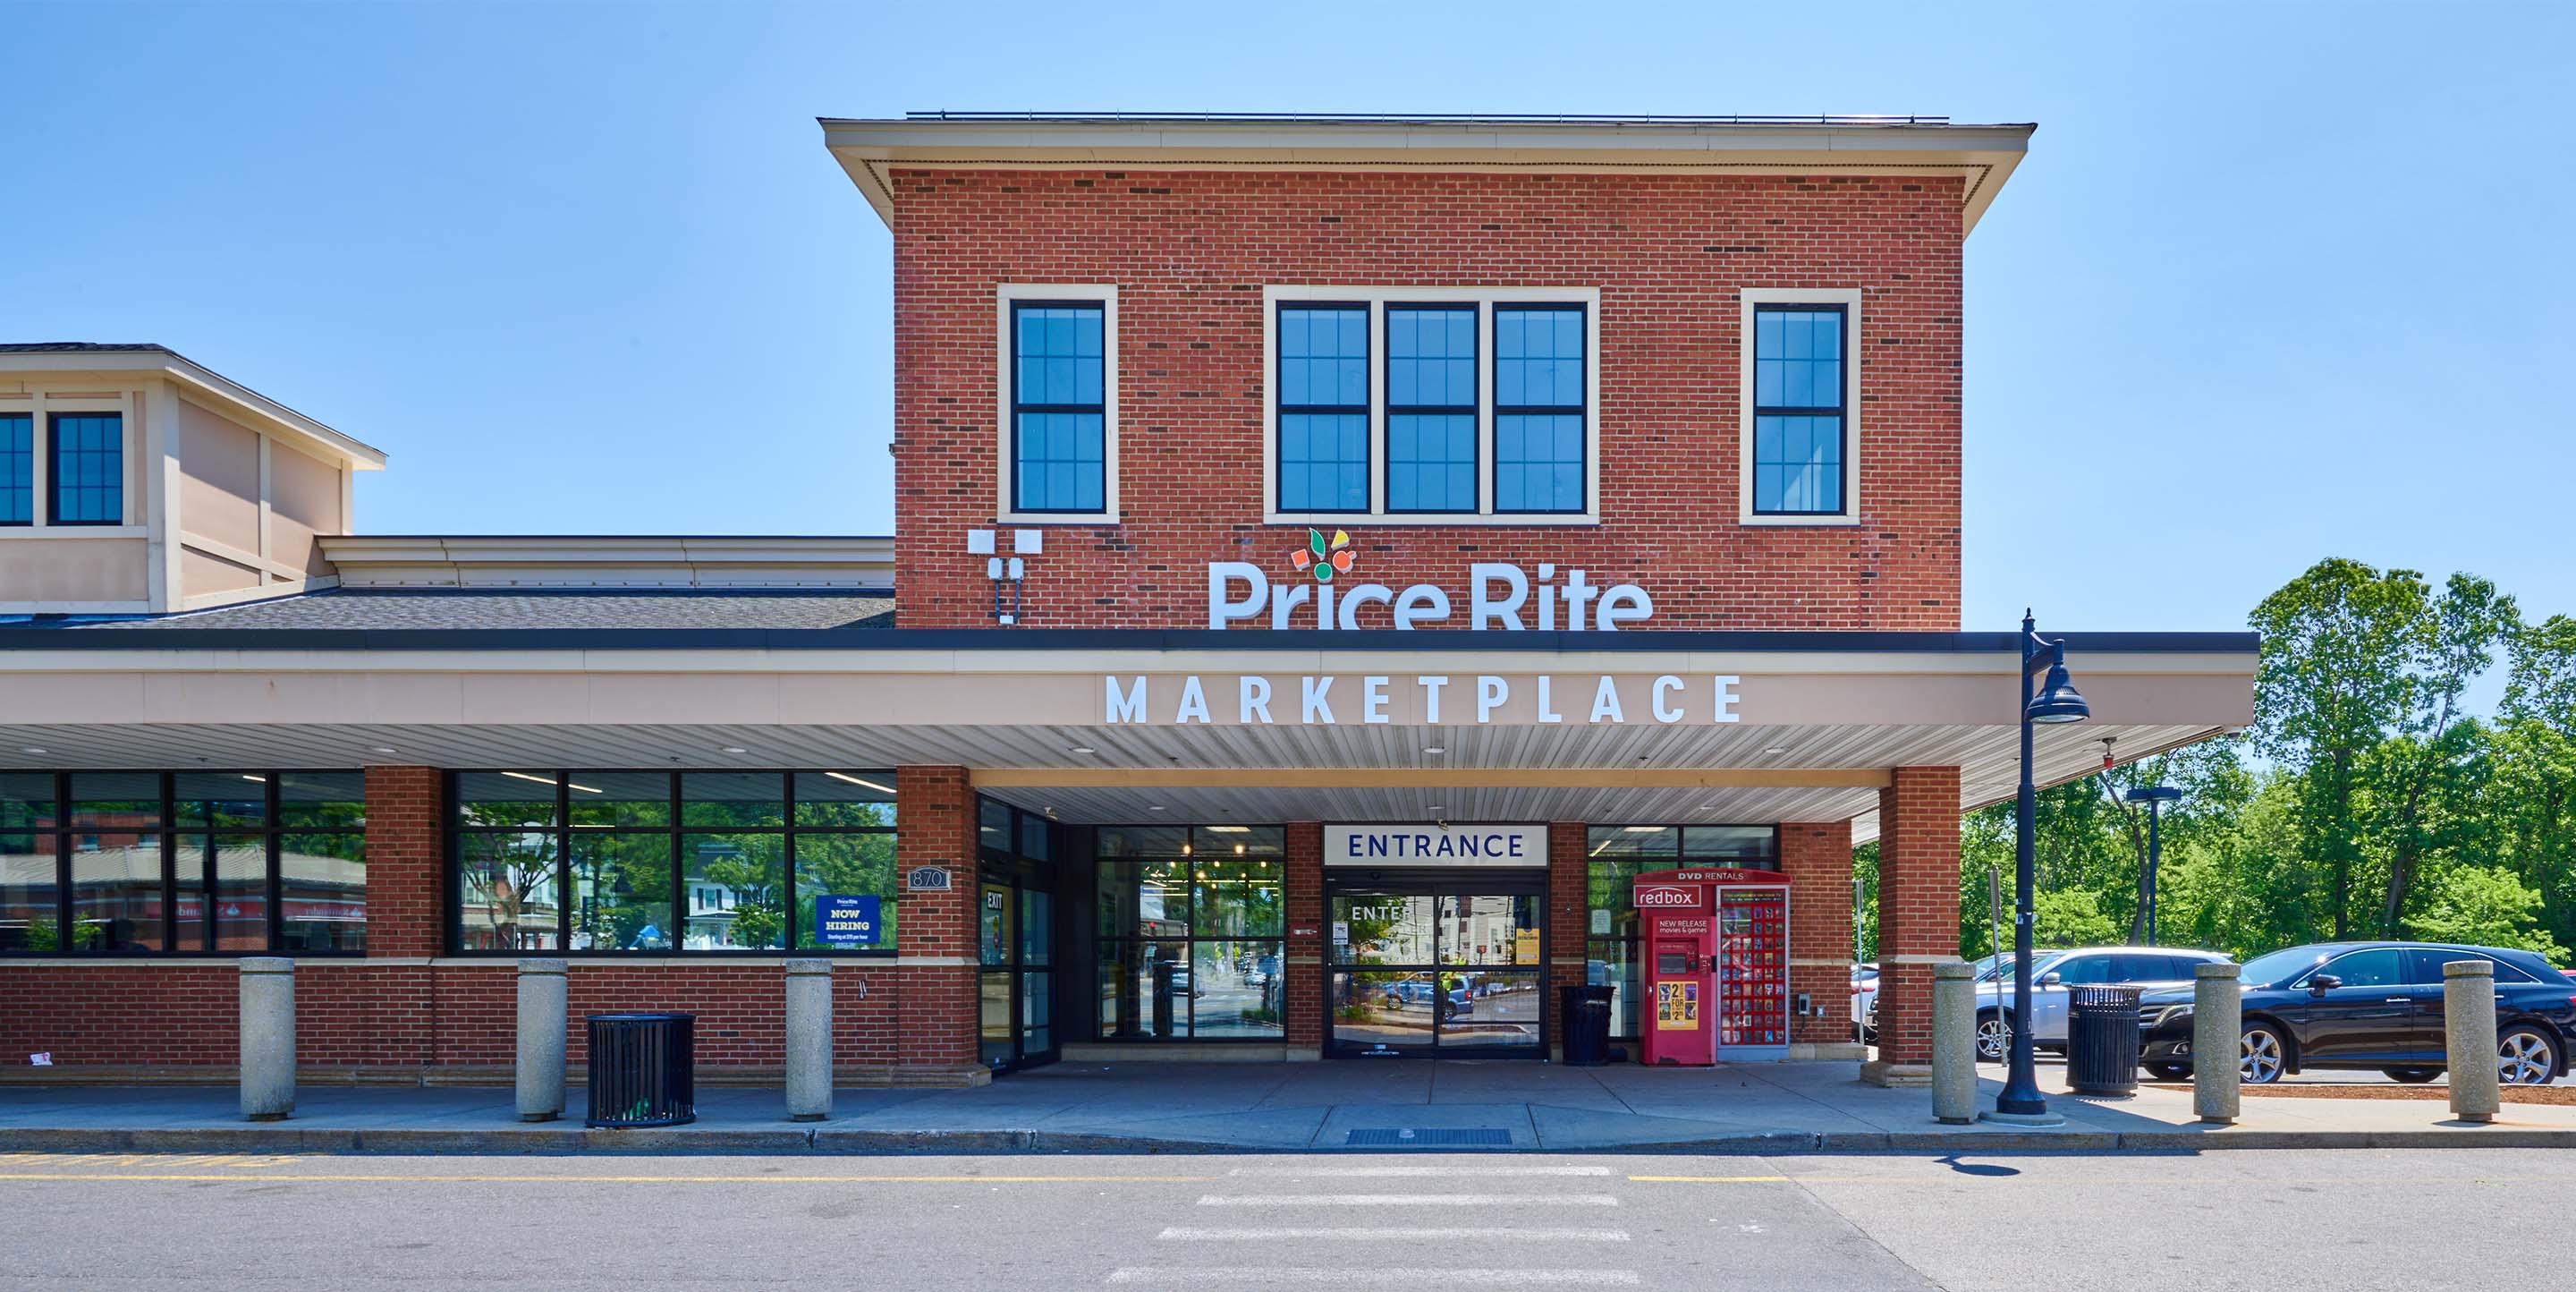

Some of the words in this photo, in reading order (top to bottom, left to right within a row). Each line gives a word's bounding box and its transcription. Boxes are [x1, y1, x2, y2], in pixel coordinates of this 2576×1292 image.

[1208, 561, 1451, 631] Price
[1470, 563, 1653, 631] Rite
[1106, 675, 1741, 724] MARKETPLACE
[1348, 834, 1523, 857] ENTRANCE
[913, 871, 942, 887] 870
[1678, 872, 1702, 880] DVD
[1705, 872, 1744, 880] RENTALS
[987, 891, 1003, 909] EXIT
[1640, 890, 1692, 904] redbox
[830, 909, 860, 919] NOW
[1352, 906, 1411, 921] ENTER
[826, 922, 870, 931] HIRING
[1659, 920, 1676, 928] NEW
[1677, 920, 1707, 928] RELEASE
[1672, 983, 1679, 998] 2
[1672, 999, 1684, 1007] FOR
